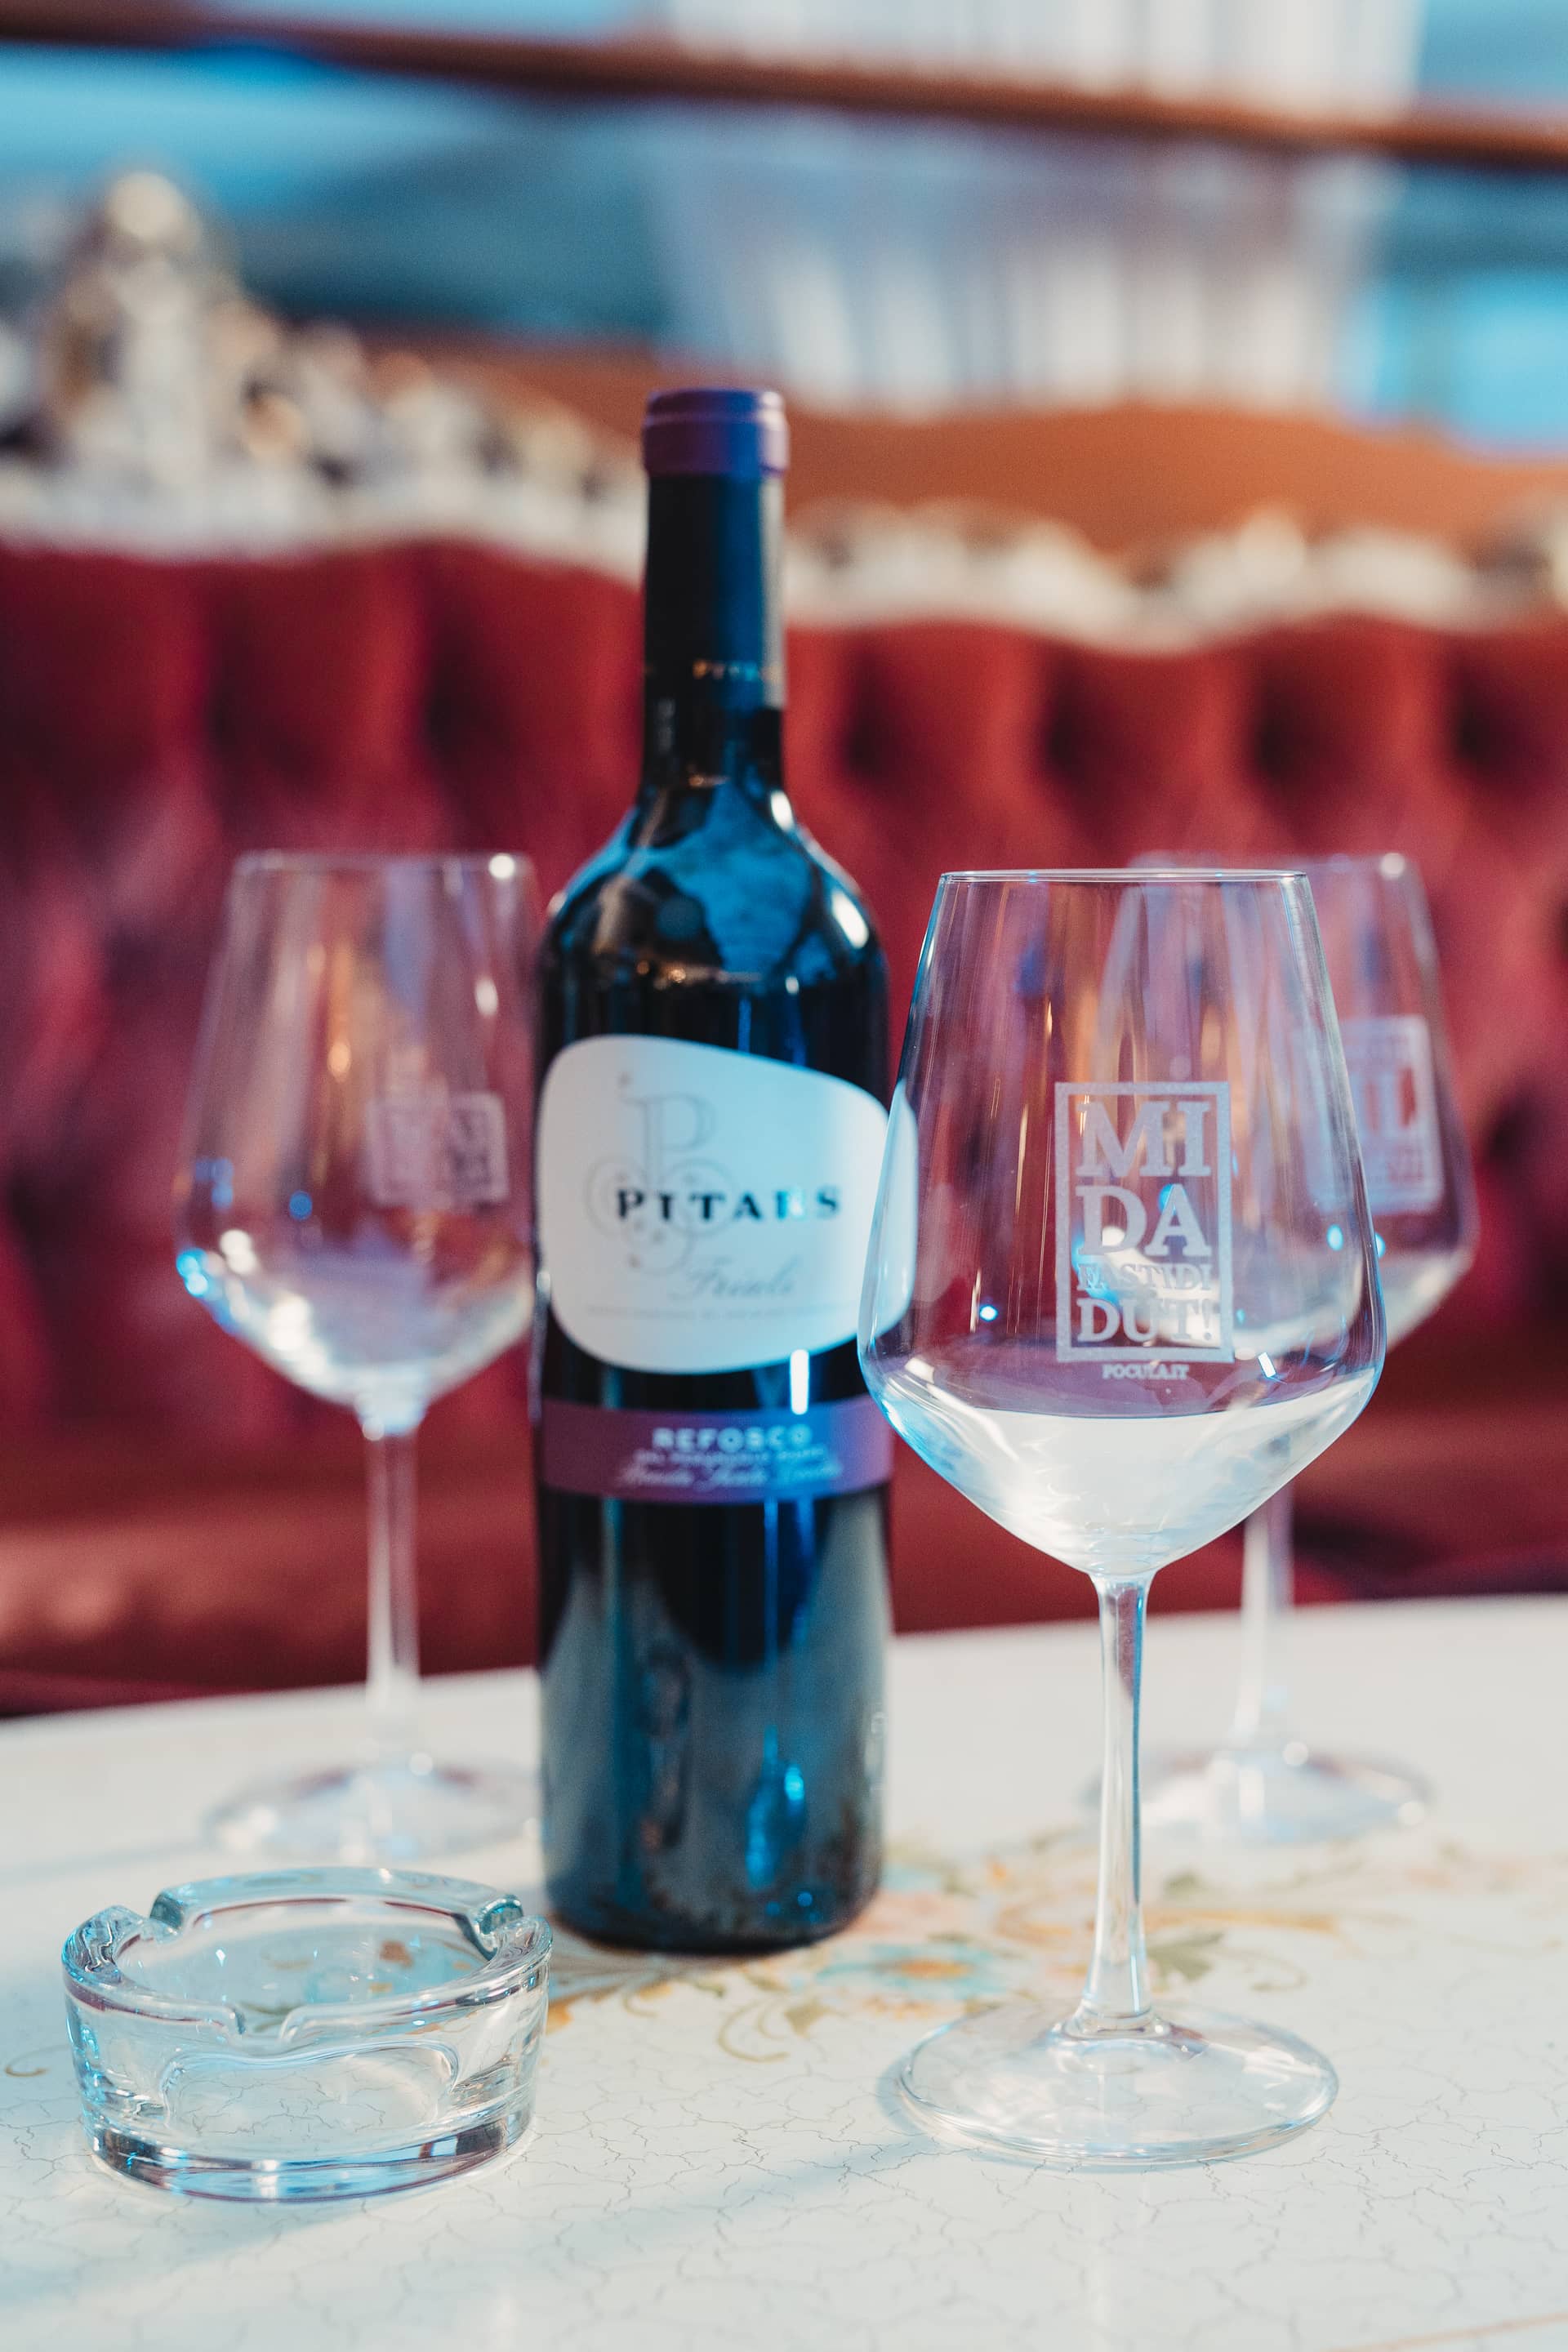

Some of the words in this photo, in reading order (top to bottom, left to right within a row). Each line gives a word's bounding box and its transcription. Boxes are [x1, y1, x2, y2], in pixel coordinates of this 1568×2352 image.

[1075, 1100, 1212, 1178] MI
[1075, 1183, 1213, 1258] DA
[1076, 1262, 1214, 1292] FASTIDI
[1076, 1297, 1214, 1343] DUT!
